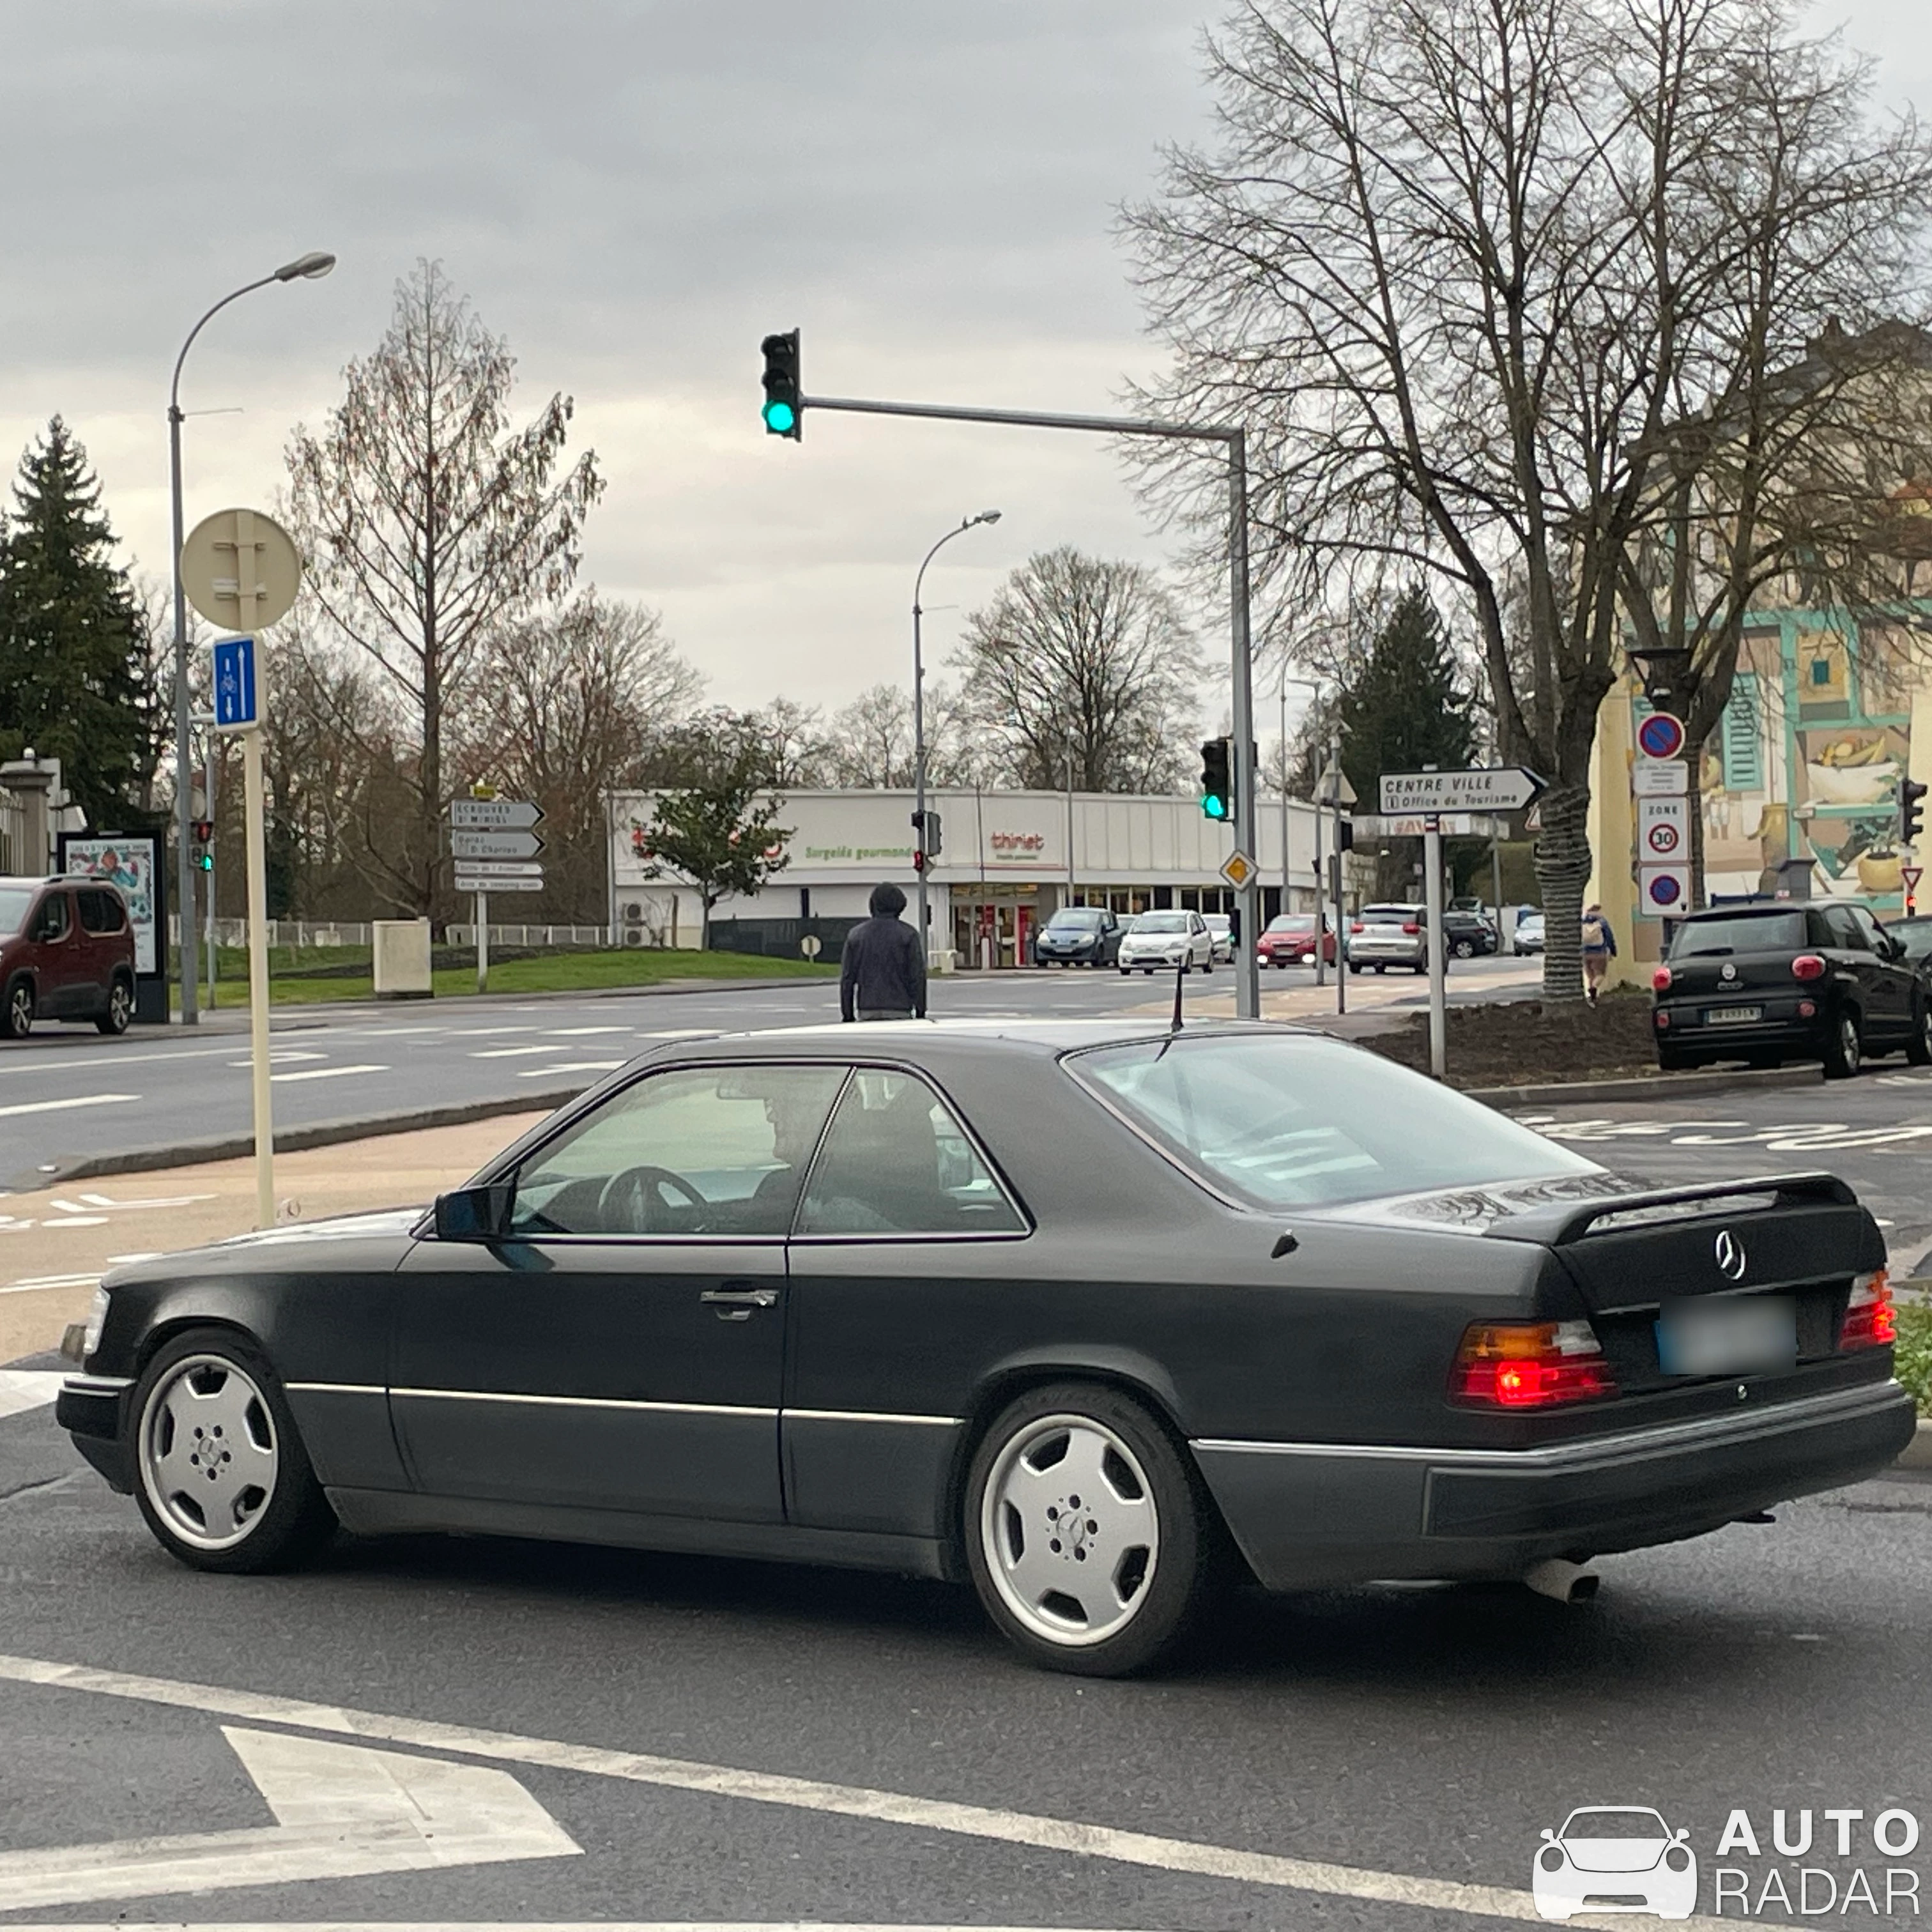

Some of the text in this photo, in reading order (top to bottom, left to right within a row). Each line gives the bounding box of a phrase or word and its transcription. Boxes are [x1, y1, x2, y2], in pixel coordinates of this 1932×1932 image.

[1385, 776, 1492, 793] CENTRE VILLE
[1402, 794, 1518, 807] Office du Tourisme
[1649, 806, 1678, 816] ZONE
[1655, 832, 1673, 845] 30
